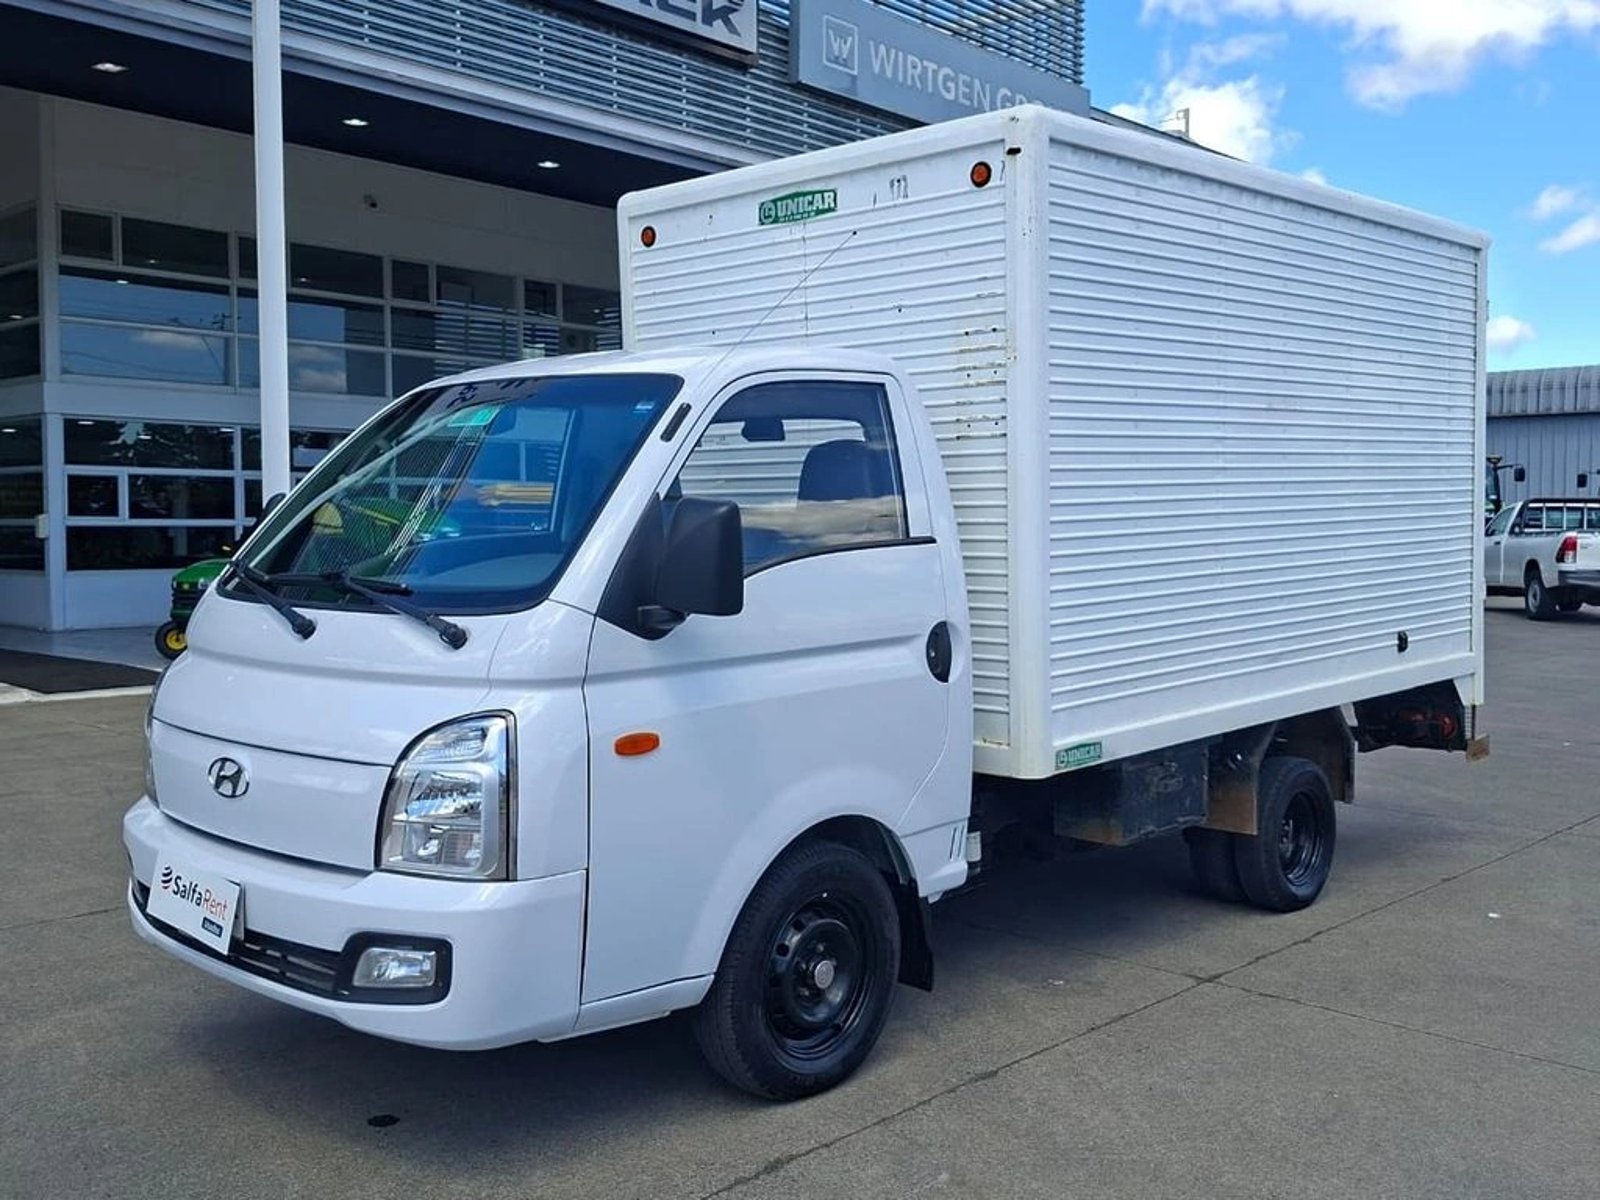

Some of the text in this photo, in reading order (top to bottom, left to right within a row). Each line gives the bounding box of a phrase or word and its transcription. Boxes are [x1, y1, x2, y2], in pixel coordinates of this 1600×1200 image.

[868, 40, 991, 112] WIRTGEN
[776, 192, 835, 218] UNICAR
[172, 875, 228, 920] SalfaRent
